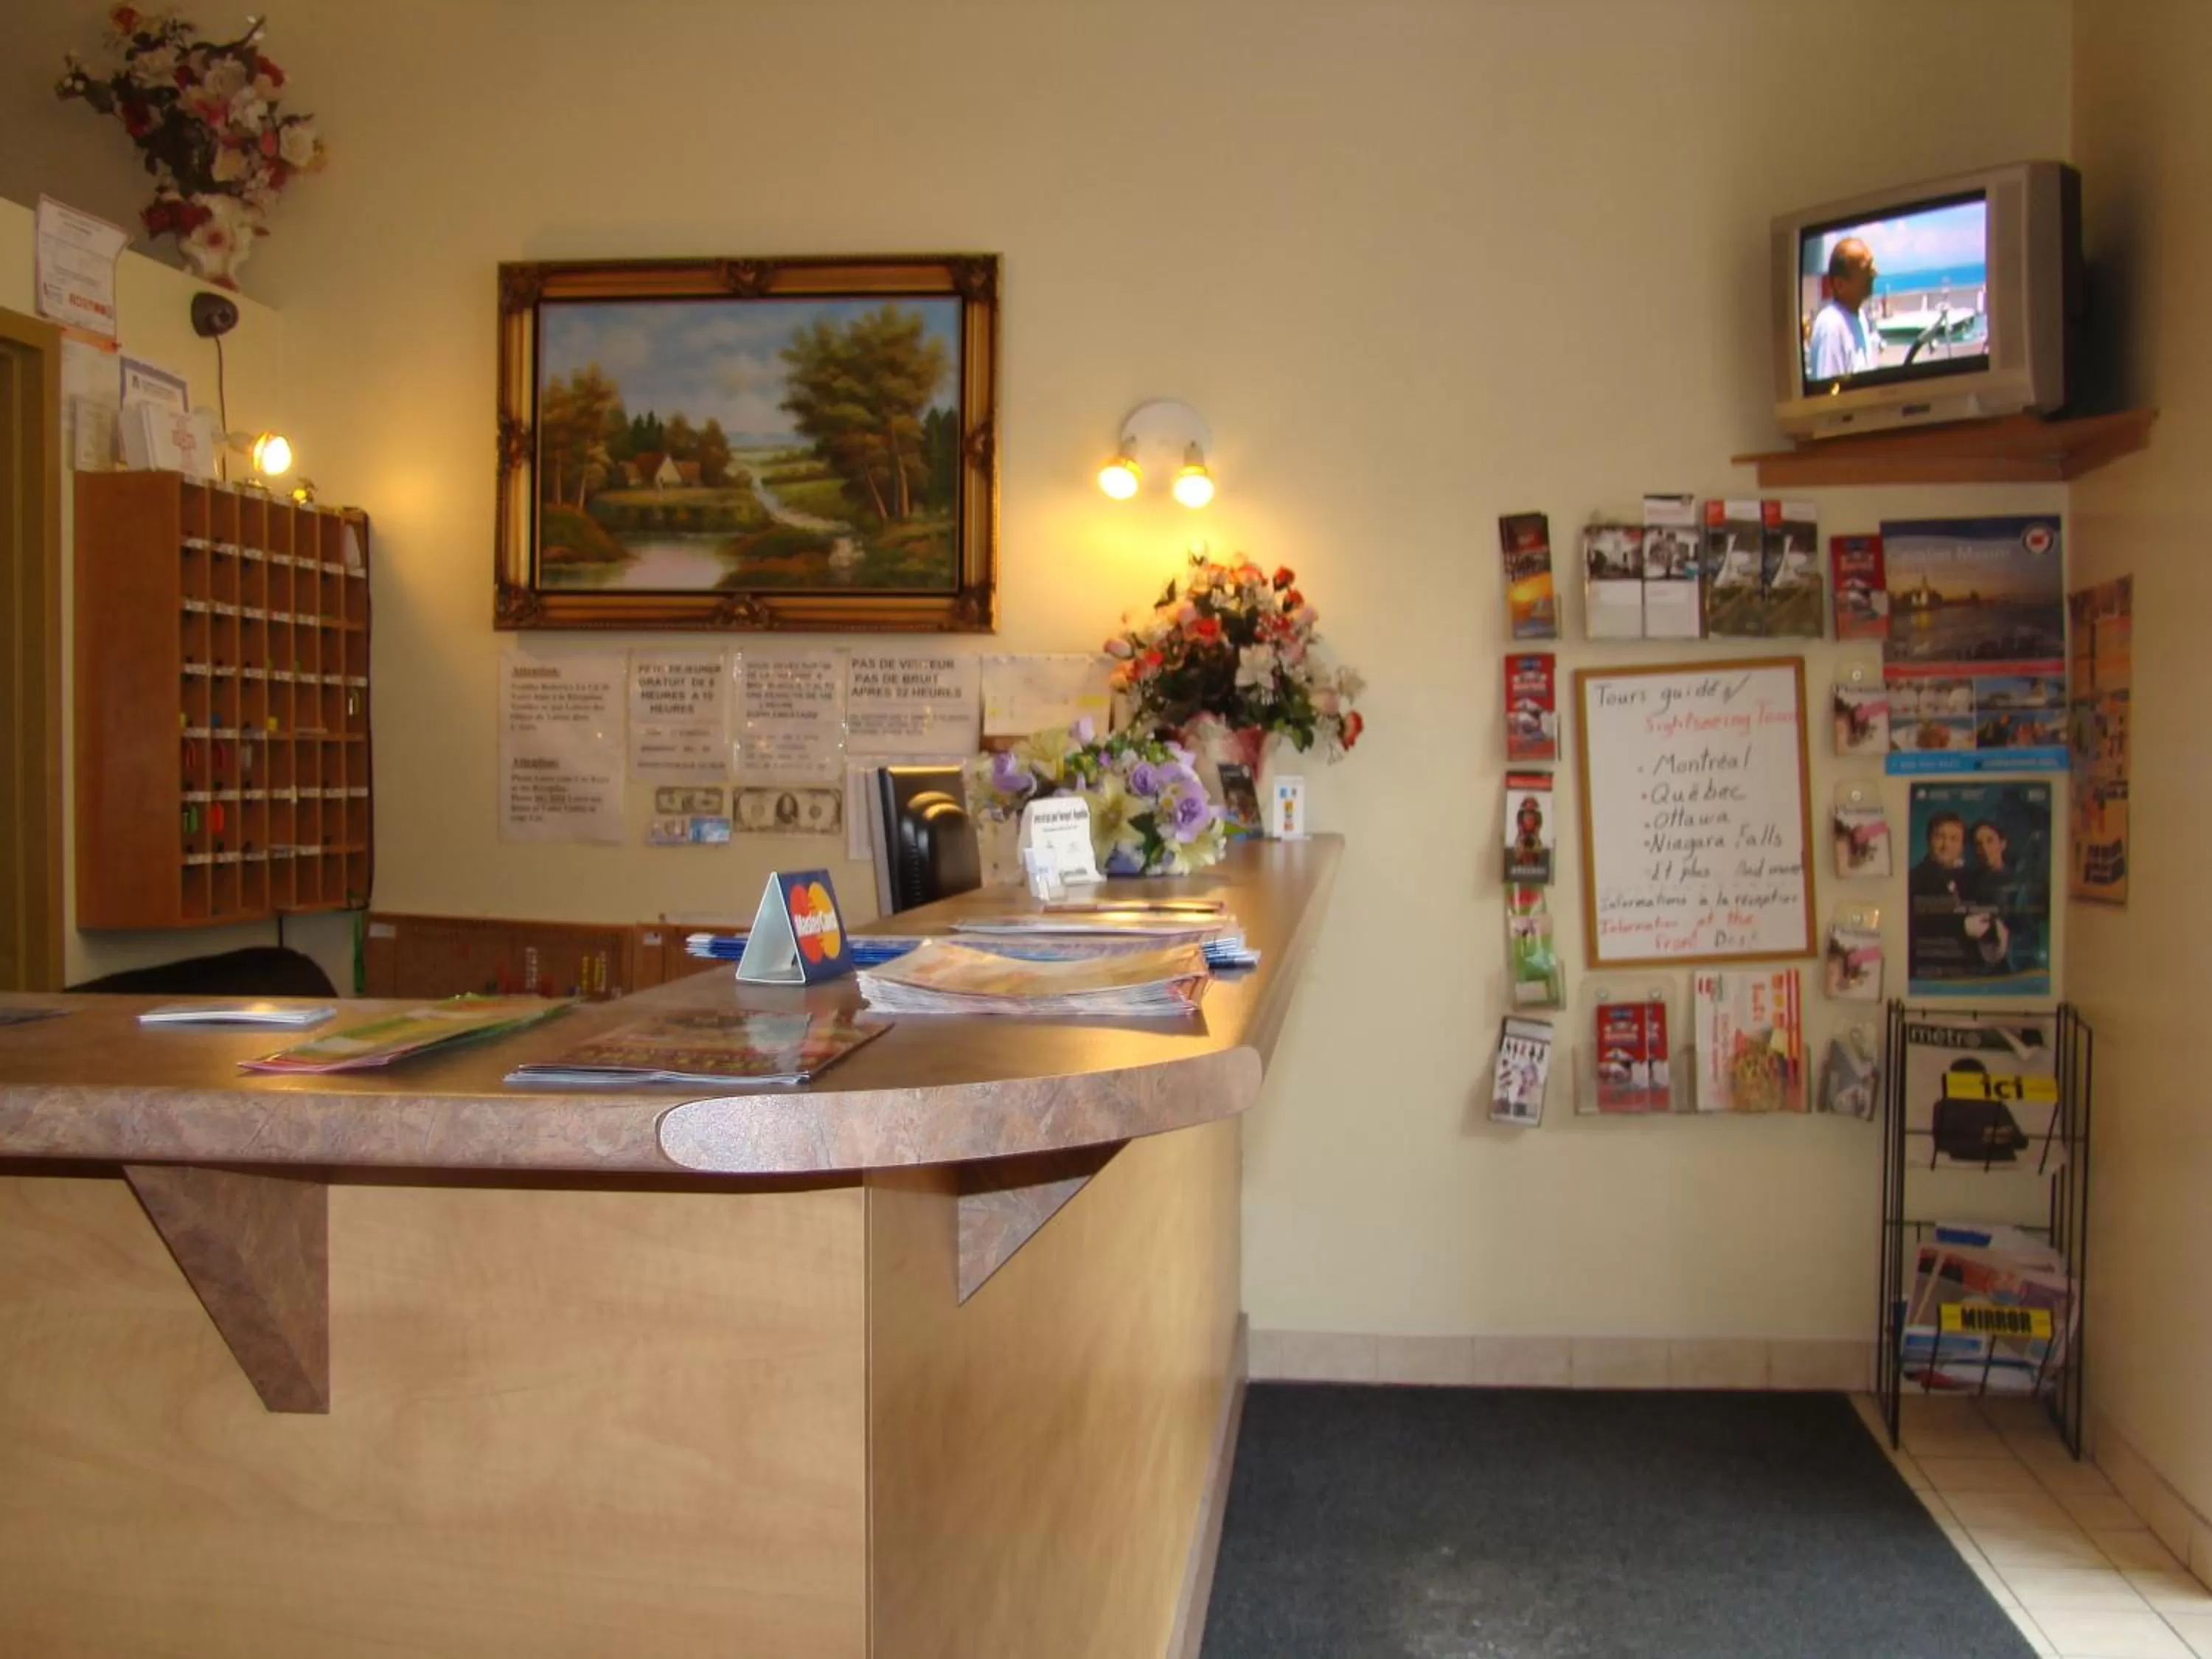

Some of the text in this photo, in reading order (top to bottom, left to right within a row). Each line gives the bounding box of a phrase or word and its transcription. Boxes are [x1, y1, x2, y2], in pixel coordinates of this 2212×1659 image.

[851, 658, 956, 670] PAS DE VIEUR
[855, 673, 937, 684] PAS DE BRUIT
[911, 687, 962, 698] HEURES
[1594, 683, 1648, 708] Tours
[1653, 806, 1731, 830] Ottawa
[1649, 823, 1783, 860] Niagara Falls
[1980, 1074, 2023, 1099] ici
[1961, 1307, 2031, 1334] MIRROR
